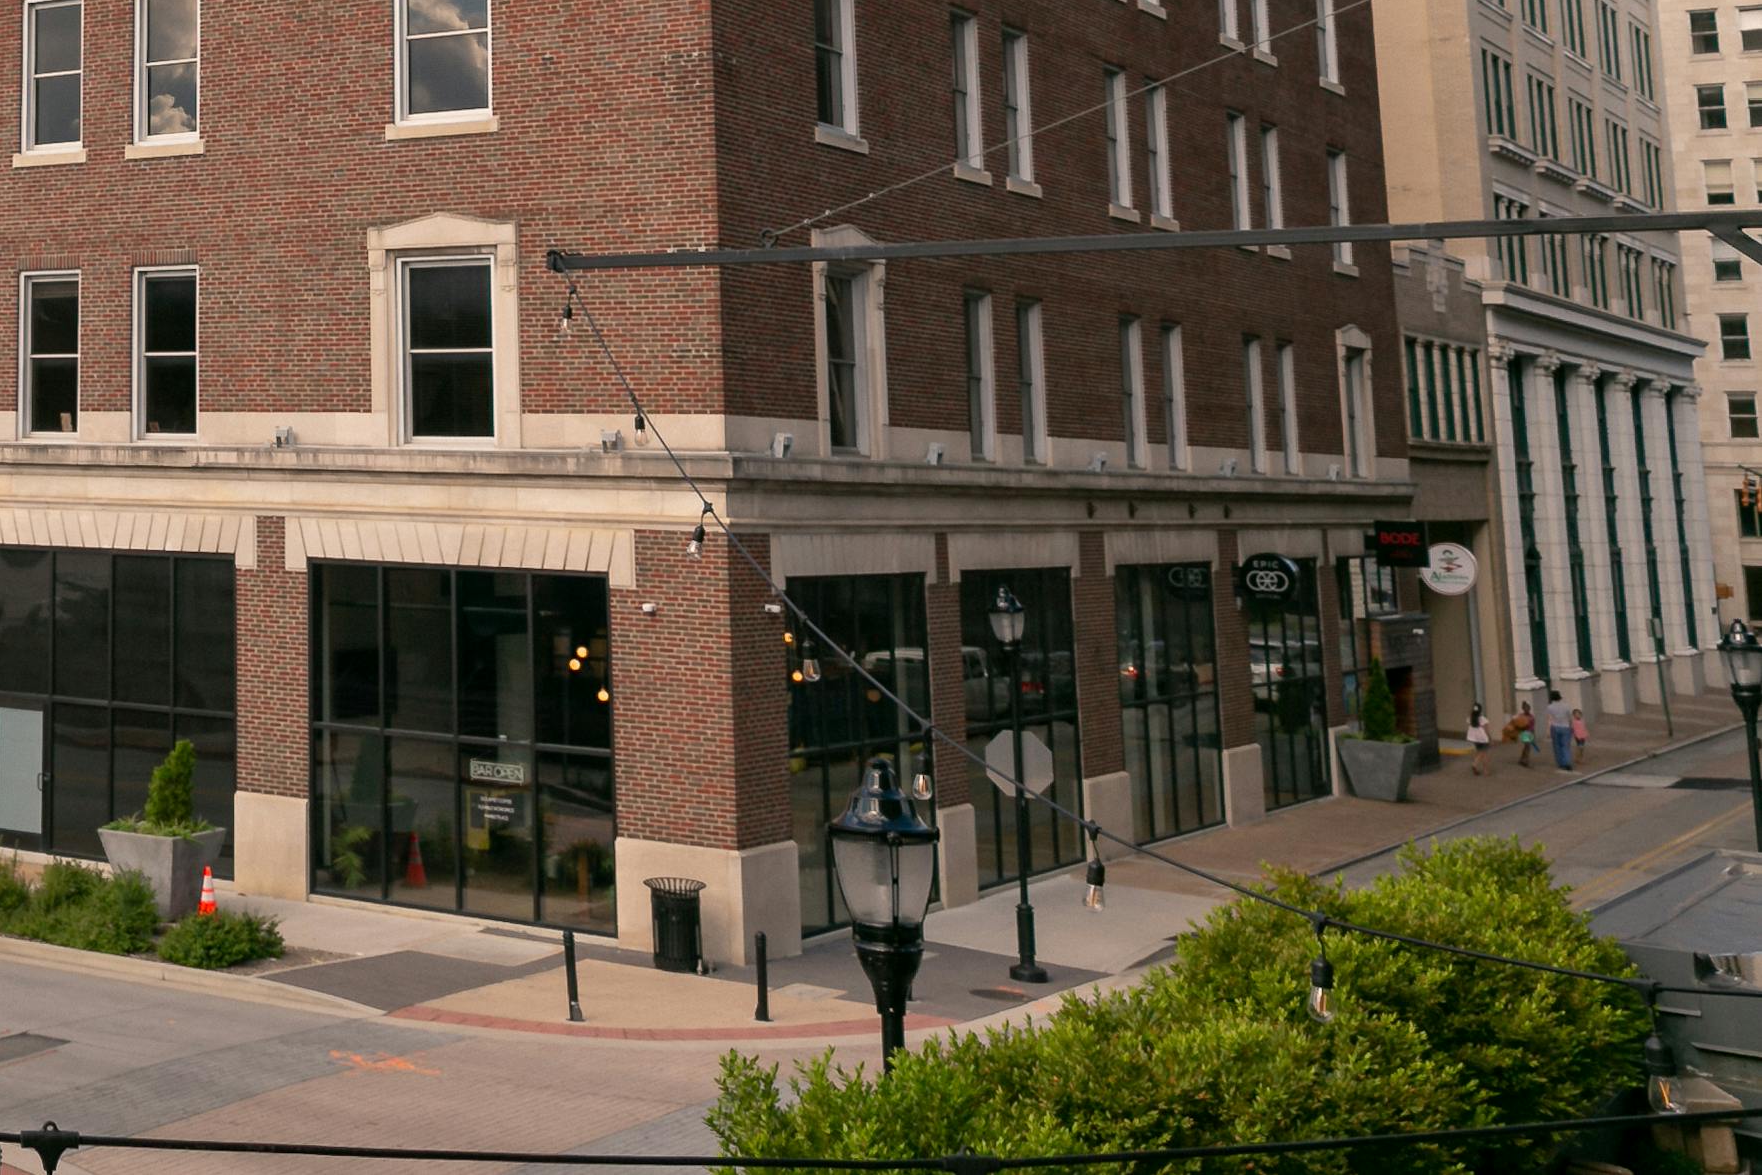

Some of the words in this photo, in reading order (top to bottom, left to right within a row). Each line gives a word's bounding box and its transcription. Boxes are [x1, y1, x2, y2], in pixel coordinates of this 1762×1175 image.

[1380, 532, 1421, 545] BODE
[1253, 560, 1279, 569] EPIC
[472, 764, 492, 777] BAR
[494, 767, 522, 781] OPEN
